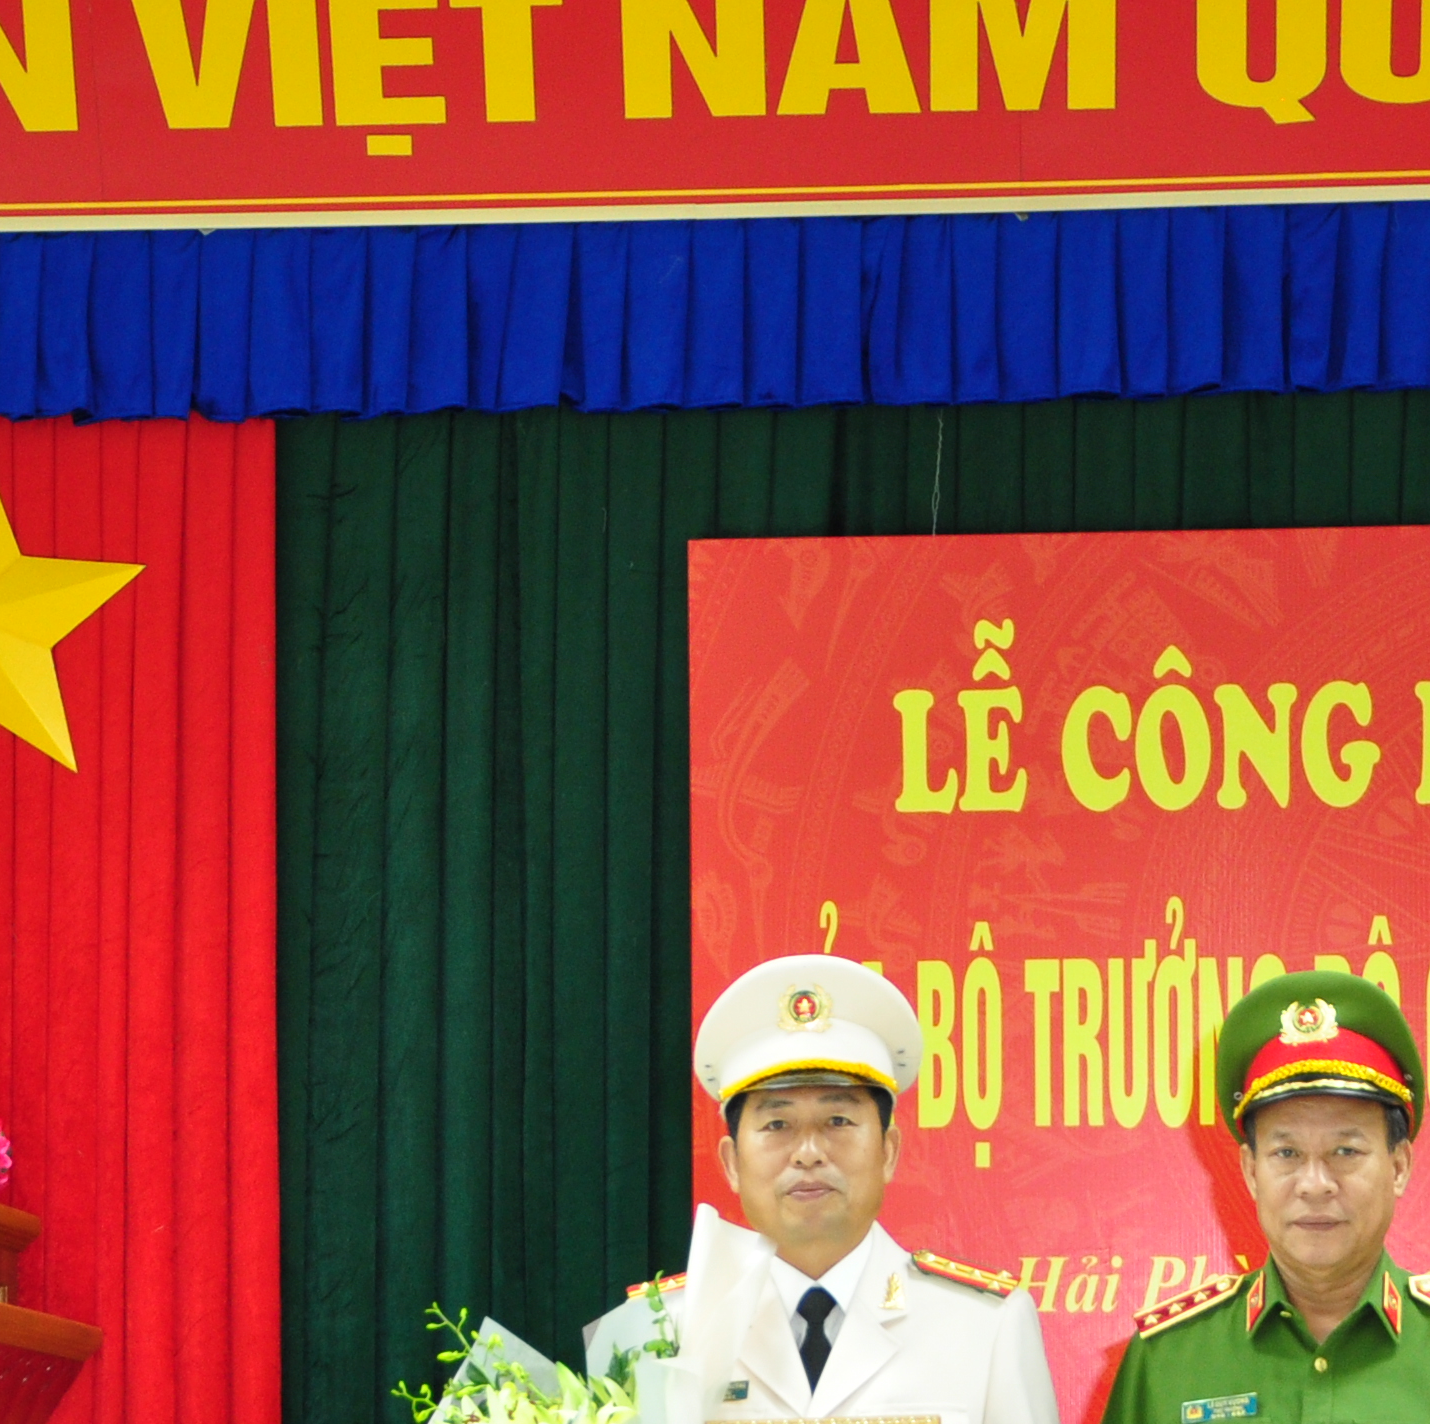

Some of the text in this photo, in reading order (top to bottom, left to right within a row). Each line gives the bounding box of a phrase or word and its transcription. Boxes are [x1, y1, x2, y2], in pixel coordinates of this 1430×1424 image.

[621, 0, 1117, 119] NAM
[892, 618, 1028, 815] LỄ
[1061, 644, 1381, 813] CÔNG
[916, 921, 1004, 1170] BỘ
[1023, 895, 1287, 1131] TRƯỞN
[1018, 1254, 1124, 1314] Hải
